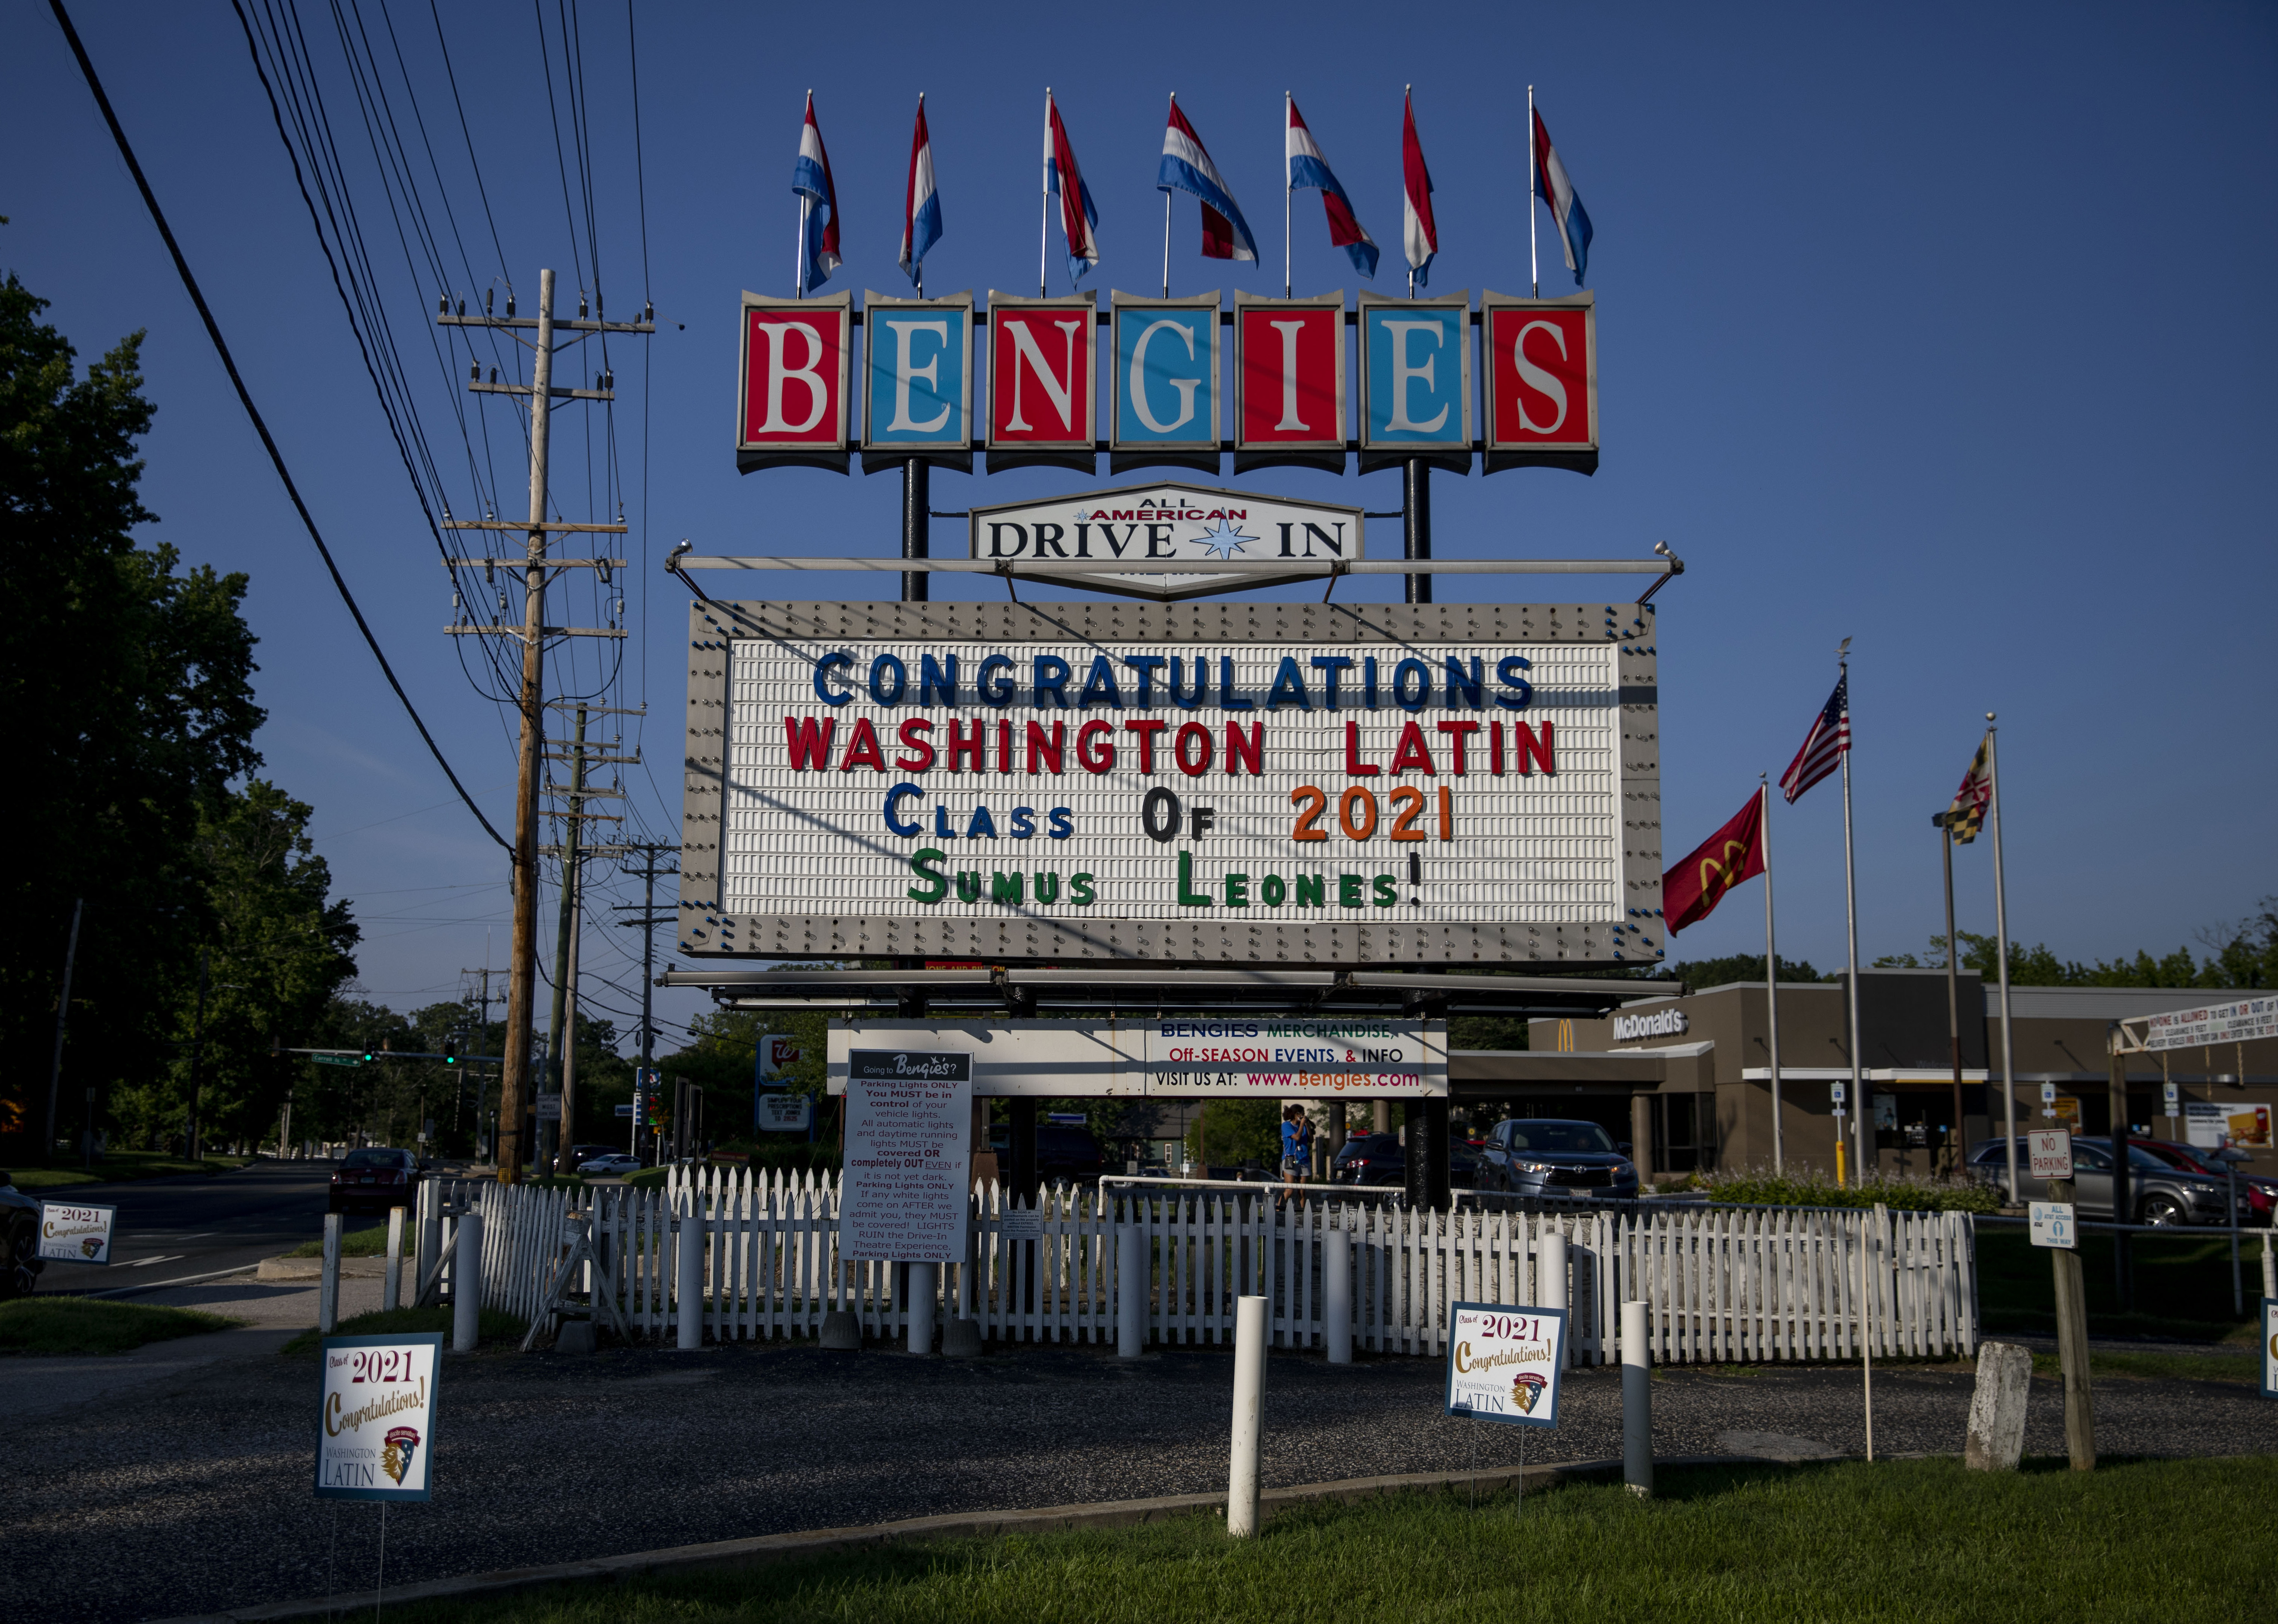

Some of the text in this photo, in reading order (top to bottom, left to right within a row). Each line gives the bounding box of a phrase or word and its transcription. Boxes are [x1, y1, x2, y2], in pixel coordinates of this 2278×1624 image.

[758, 319, 1569, 435] BENGIES
[1140, 498, 1195, 508] ALL
[1089, 509, 1246, 521] AMERICAN
[987, 523, 1345, 558] DRIVE IN
[813, 652, 1532, 710] CONGRATULATIONS
[784, 716, 1553, 776] WASHINGTON LATIN
[883, 782, 1451, 841] CLASS OF 2021
[907, 847, 1419, 907] SUMUS LEONES!
[2181, 1010, 2208, 1023] ALLOWED
[2219, 1009, 2228, 1018] GET
[2251, 1001, 2263, 1013] OUT
[1161, 1024, 1395, 1040] BENGIES MERCHANDISE,
[1613, 1009, 1683, 1040] McDonald's
[1169, 1048, 1403, 1064] Off-SEASON EVENTS, & INFO
[864, 1066, 885, 1075] Going
[1156, 1069, 1419, 1091] VISIT US AT: www.Bengies.com
[912, 1111, 940, 1119] lights.
[928, 1121, 953, 1130] lights
[921, 1131, 958, 1140] running
[871, 1140, 896, 1148] lights
[2041, 1138, 2055, 1151] NO
[851, 1158, 901, 1170] completely
[904, 1159, 924, 1168] OUT
[2034, 1157, 2068, 1170] PARKING
[923, 1192, 949, 1201] lights
[61, 1208, 100, 1222] 2021
[905, 1212, 926, 1220] they
[43, 1220, 107, 1238] Congratulations!
[42, 1246, 77, 1258] LATIN
[895, 1242, 951, 1251] Experience.
[1459, 1315, 1541, 1342] Class of 2021
[1455, 1338, 1551, 1373] Congratulations!
[329, 1350, 414, 1383] Class of 2021
[1456, 1380, 1505, 1393] WASHINGTON
[325, 1376, 424, 1437] Congratulations!
[1455, 1388, 1504, 1412] LATIN
[390, 1430, 416, 1438] discite servaturi
[326, 1447, 376, 1458] WASHINGTON
[324, 1459, 375, 1486] LATIN
